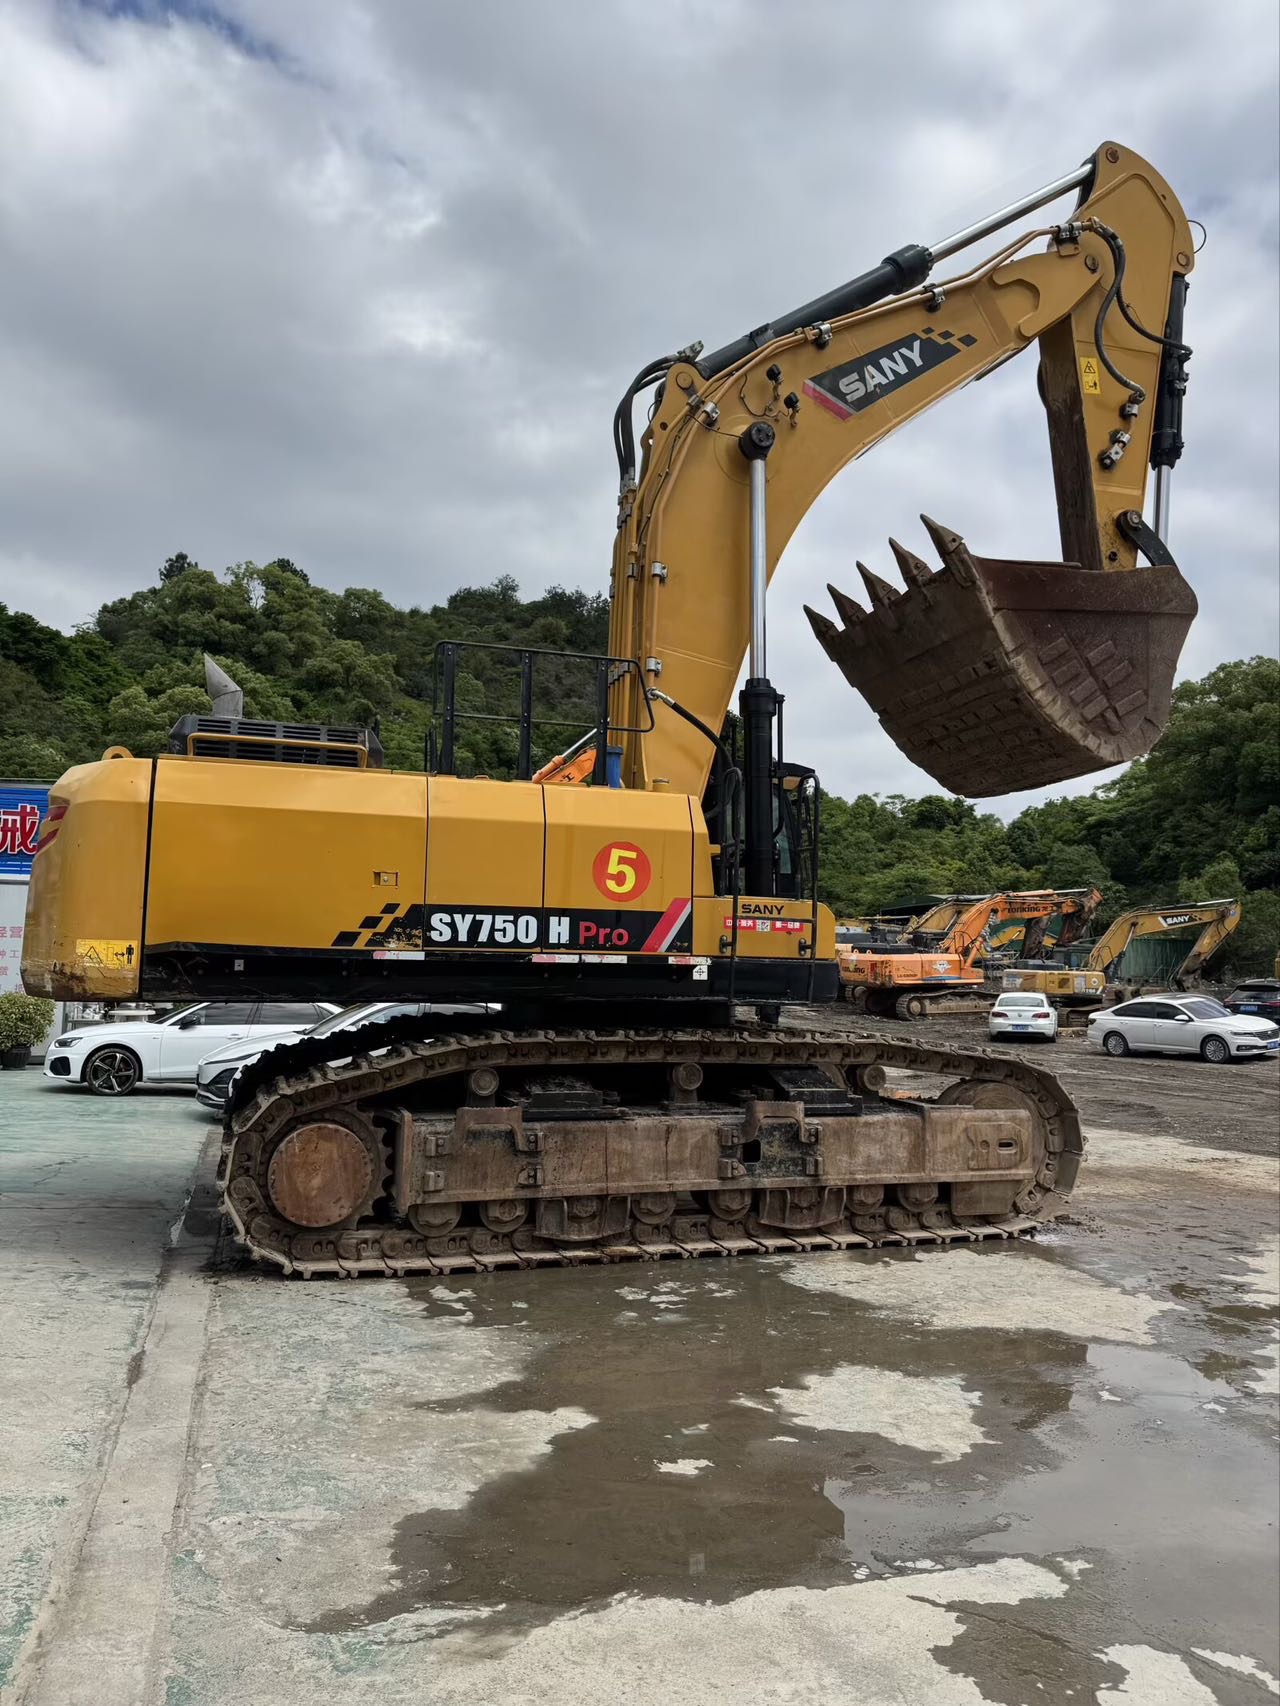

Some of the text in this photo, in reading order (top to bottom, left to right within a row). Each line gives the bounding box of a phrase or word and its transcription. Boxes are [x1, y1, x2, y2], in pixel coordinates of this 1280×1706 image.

[838, 339, 924, 403] SANY
[605, 848, 638, 893] 5
[741, 904, 784, 915] SANY
[1166, 915, 1190, 925] SANY
[430, 912, 629, 946] SY750 H Pro
